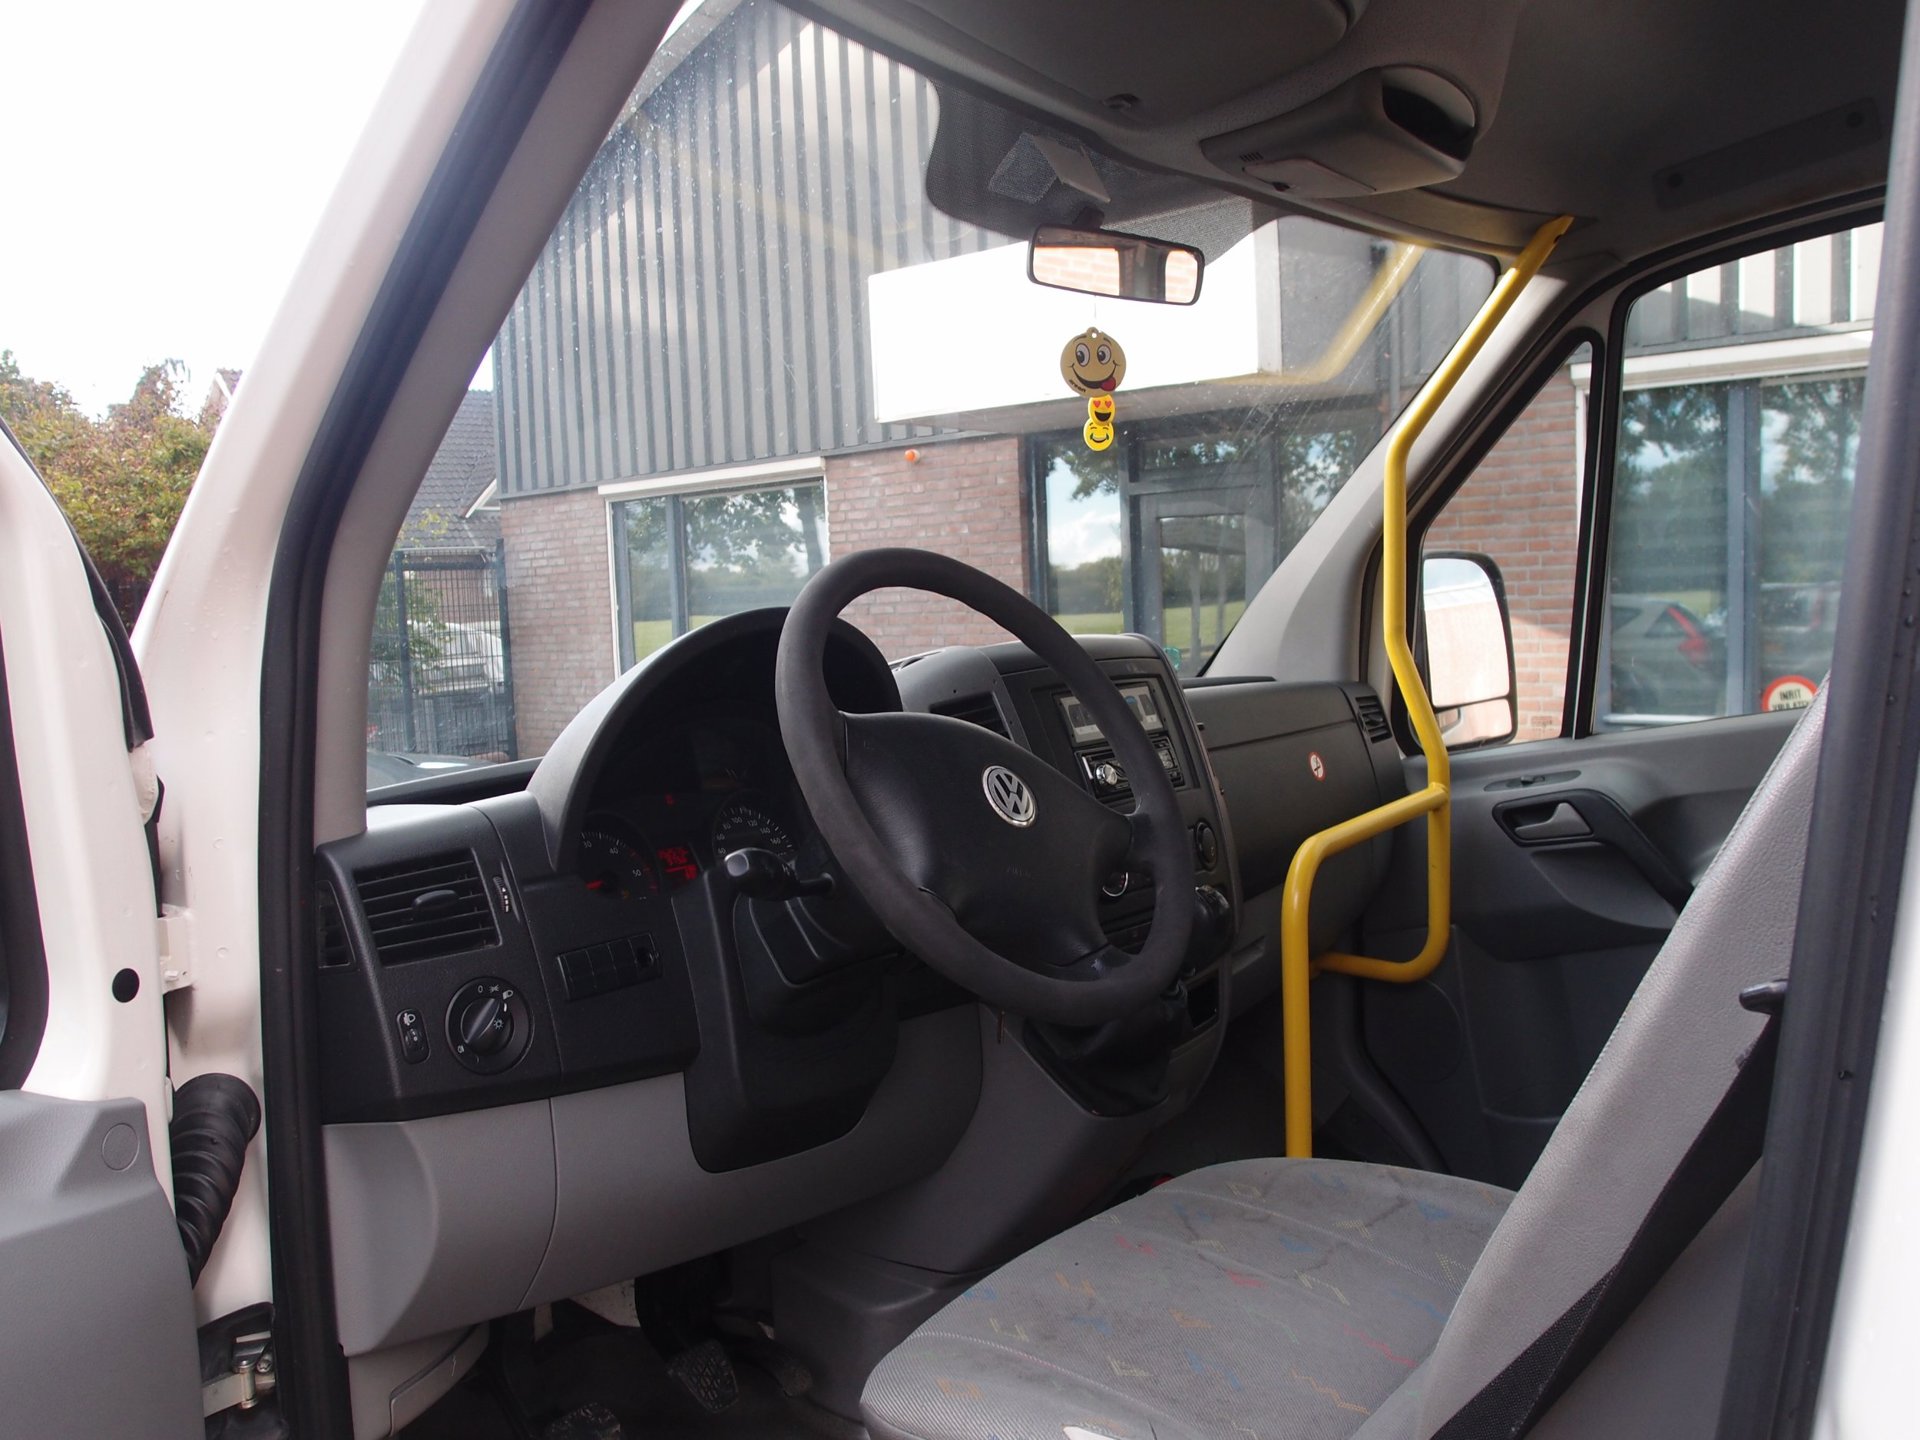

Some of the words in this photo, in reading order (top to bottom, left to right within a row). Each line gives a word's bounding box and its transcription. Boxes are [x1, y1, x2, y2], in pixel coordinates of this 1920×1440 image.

[731, 816, 743, 824] 100
[747, 819, 758, 827] 120
[632, 868, 642, 877] 50
